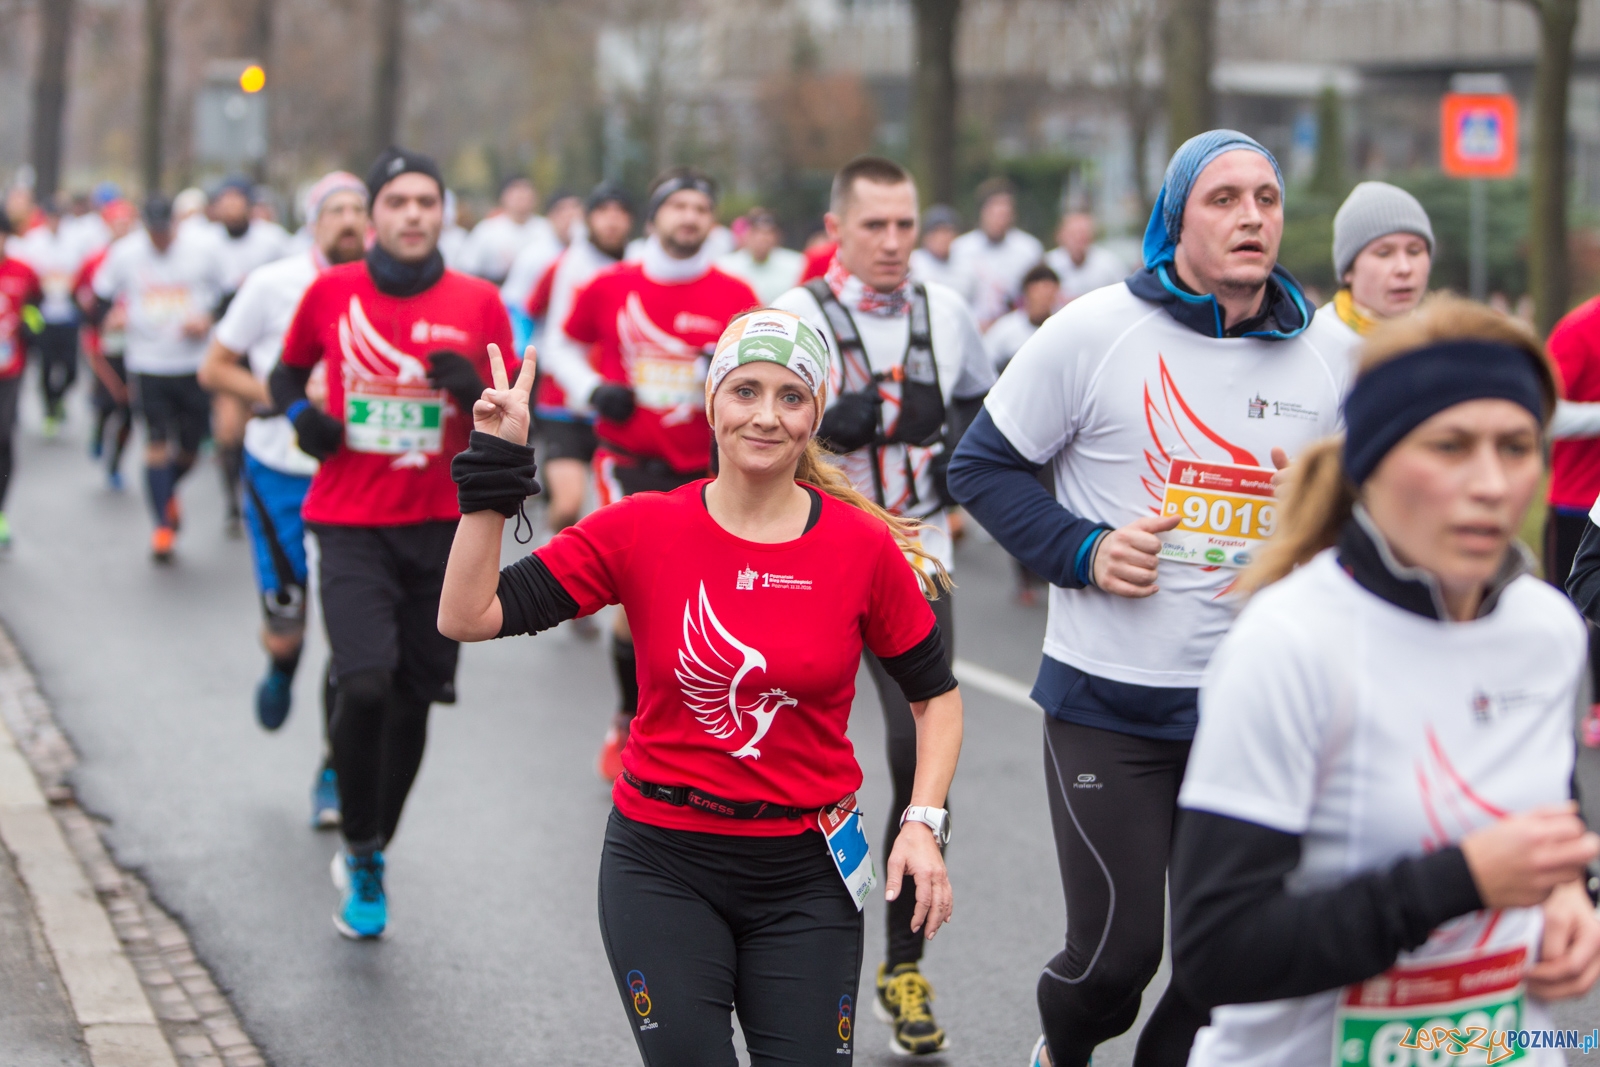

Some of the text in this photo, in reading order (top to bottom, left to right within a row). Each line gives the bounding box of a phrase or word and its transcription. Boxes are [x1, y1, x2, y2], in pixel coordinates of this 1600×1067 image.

[366, 400, 422, 428] 253
[1167, 495, 1278, 537] D 9019
[1163, 542, 1185, 551] GRUPA
[1208, 537, 1246, 547] Krzysztof
[761, 572, 770, 588] 1
[836, 848, 846, 864] E
